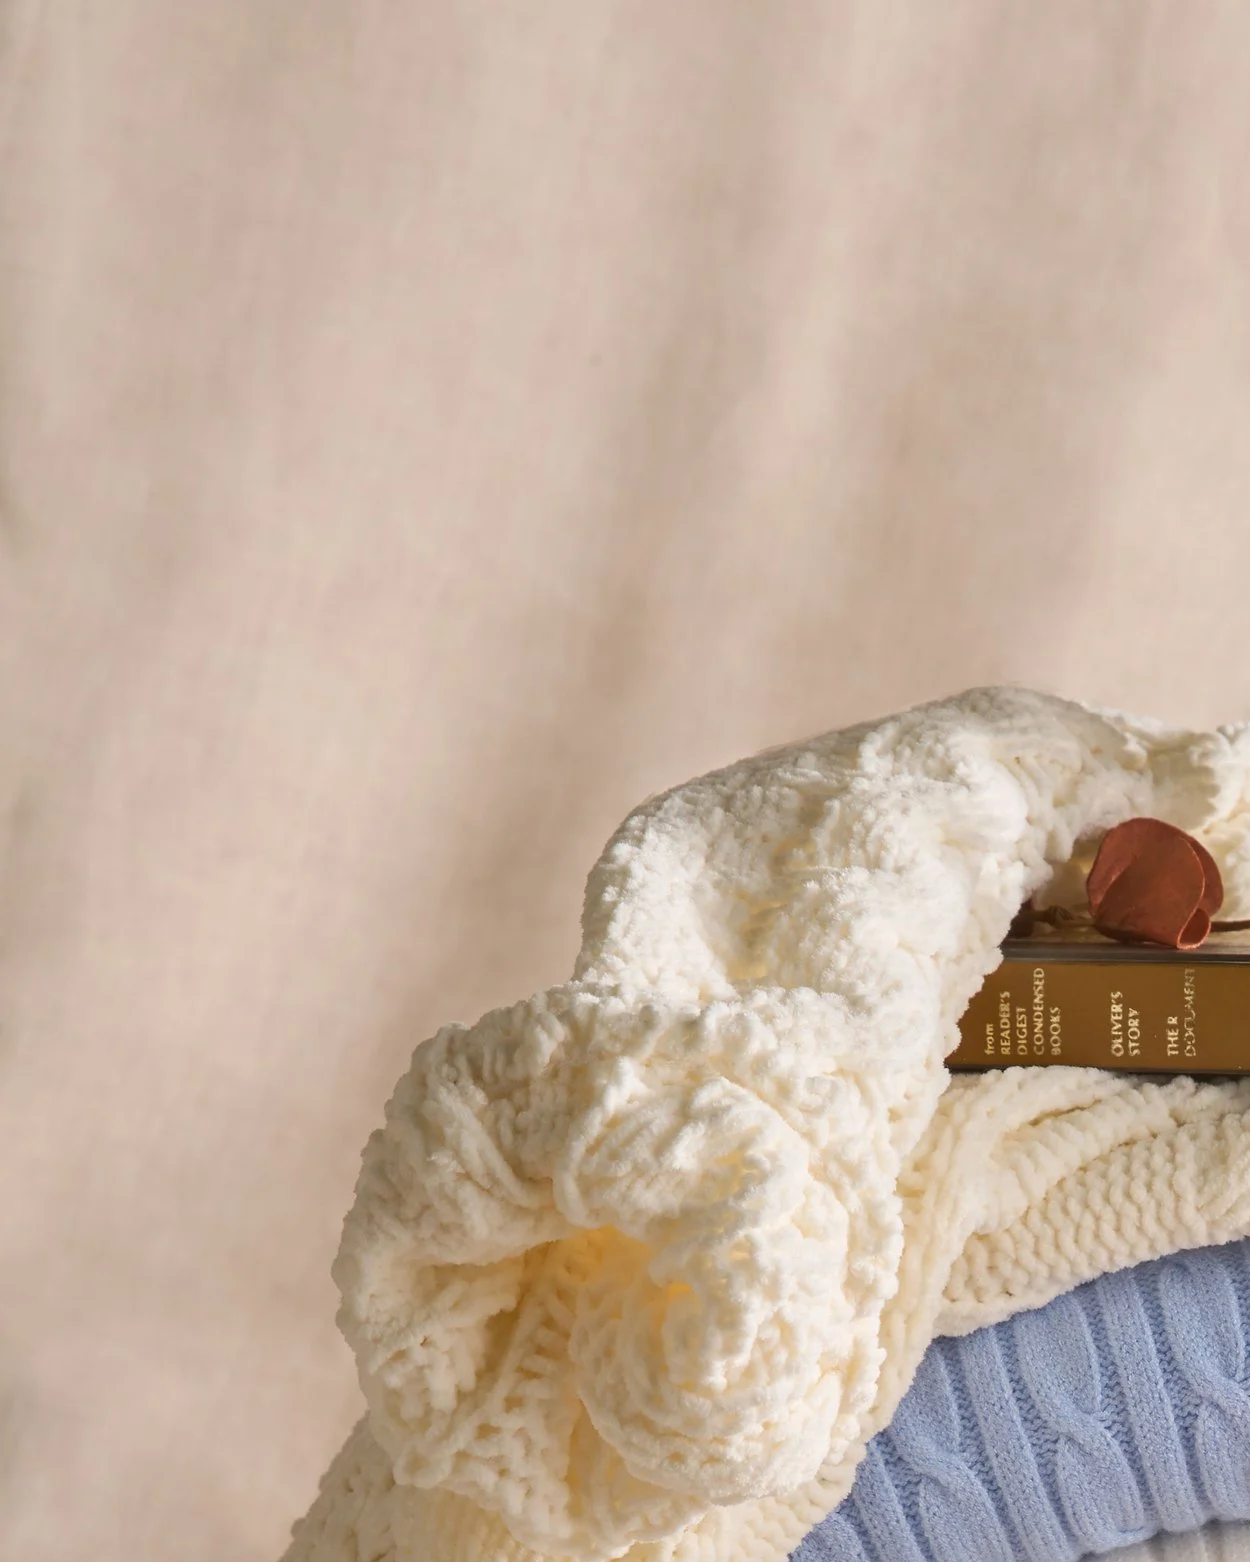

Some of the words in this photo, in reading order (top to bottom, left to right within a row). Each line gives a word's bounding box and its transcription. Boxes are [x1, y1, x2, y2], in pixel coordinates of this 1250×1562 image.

[999, 991, 1012, 1056] READER'S
[1015, 1006, 1028, 1056] DIGEST
[1032, 968, 1045, 1056] CONDENSED
[1050, 1006, 1062, 1056] BOOKS
[1110, 991, 1124, 1057] OLIVER'S
[1127, 1007, 1141, 1056] STORY
[1167, 1016, 1178, 1025] R
[984, 1023, 995, 1056] from
[1167, 1028, 1179, 1057] THE
